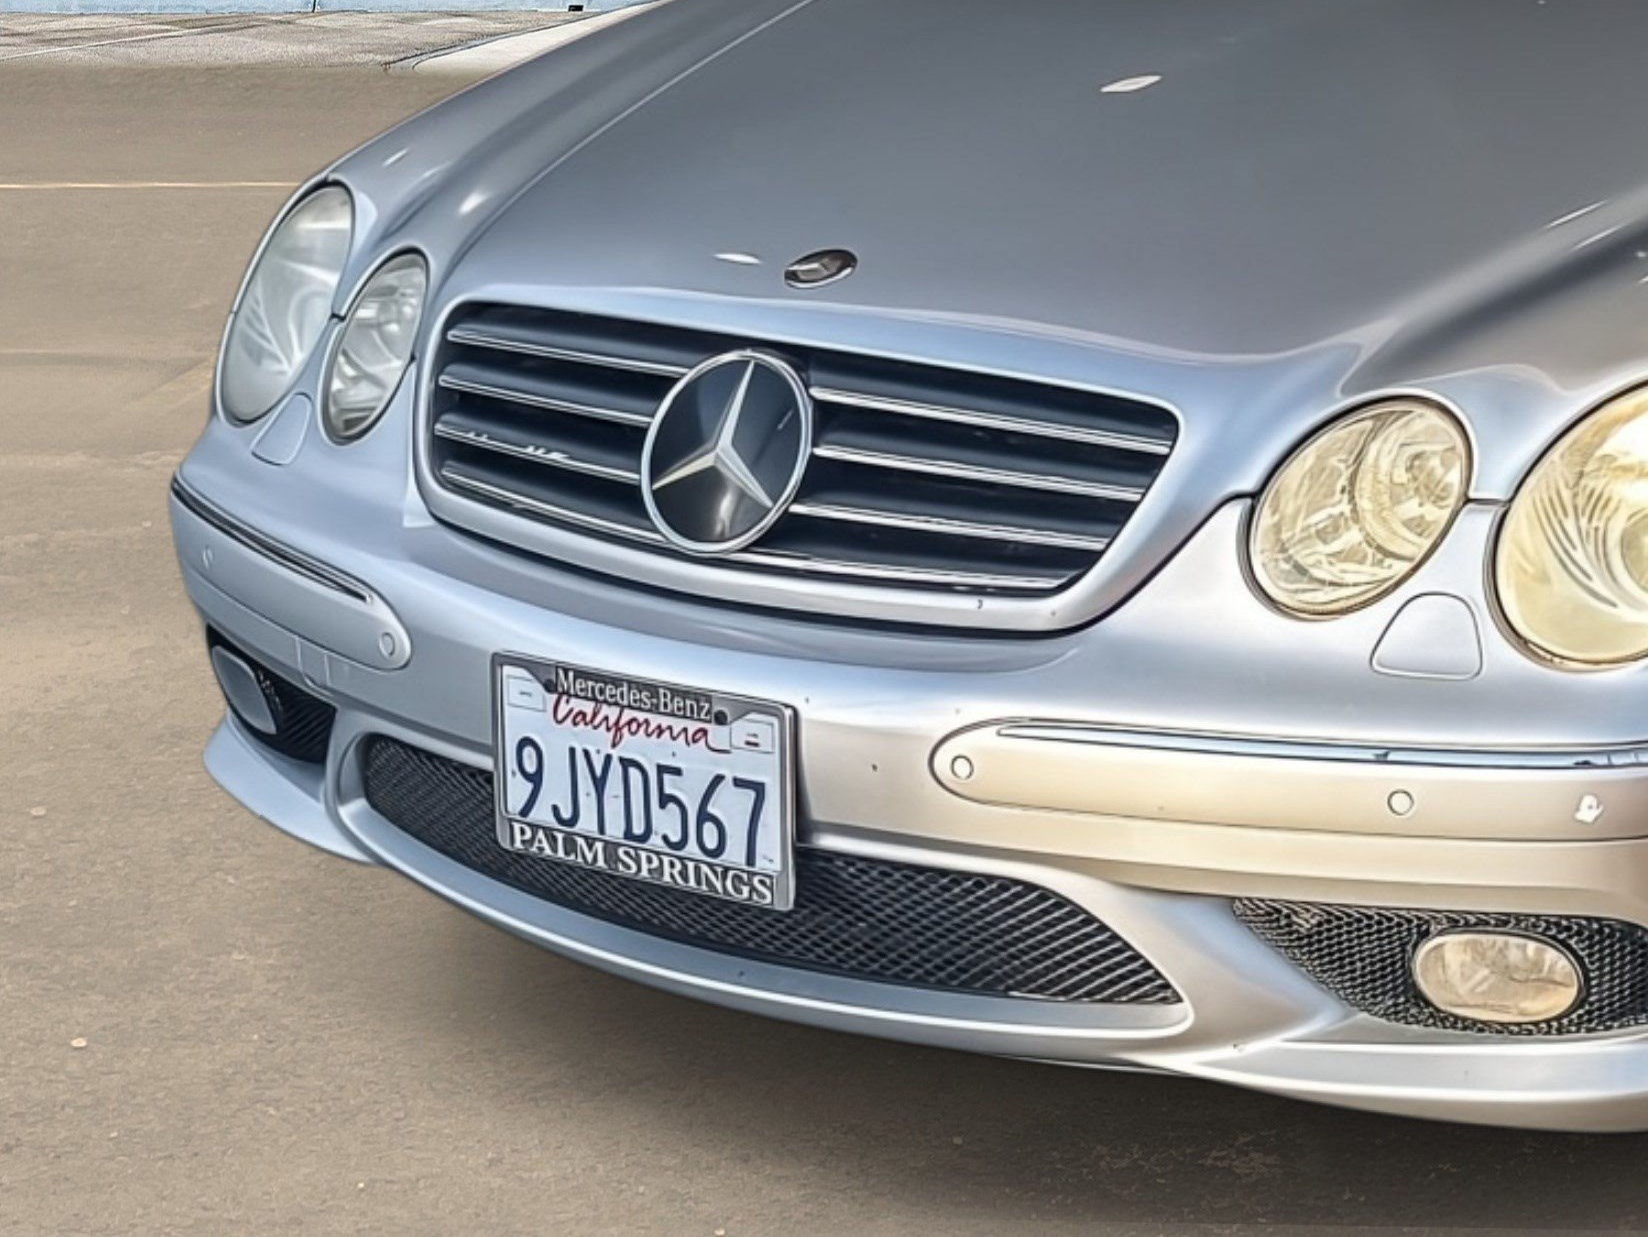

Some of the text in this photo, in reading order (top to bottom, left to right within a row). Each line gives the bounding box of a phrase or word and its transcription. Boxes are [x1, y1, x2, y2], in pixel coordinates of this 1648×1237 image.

[551, 692, 732, 752] California
[555, 667, 712, 722] Mercedes-Benz
[514, 736, 767, 867] 9JYD567
[511, 821, 775, 906] PALM SPRINGS
